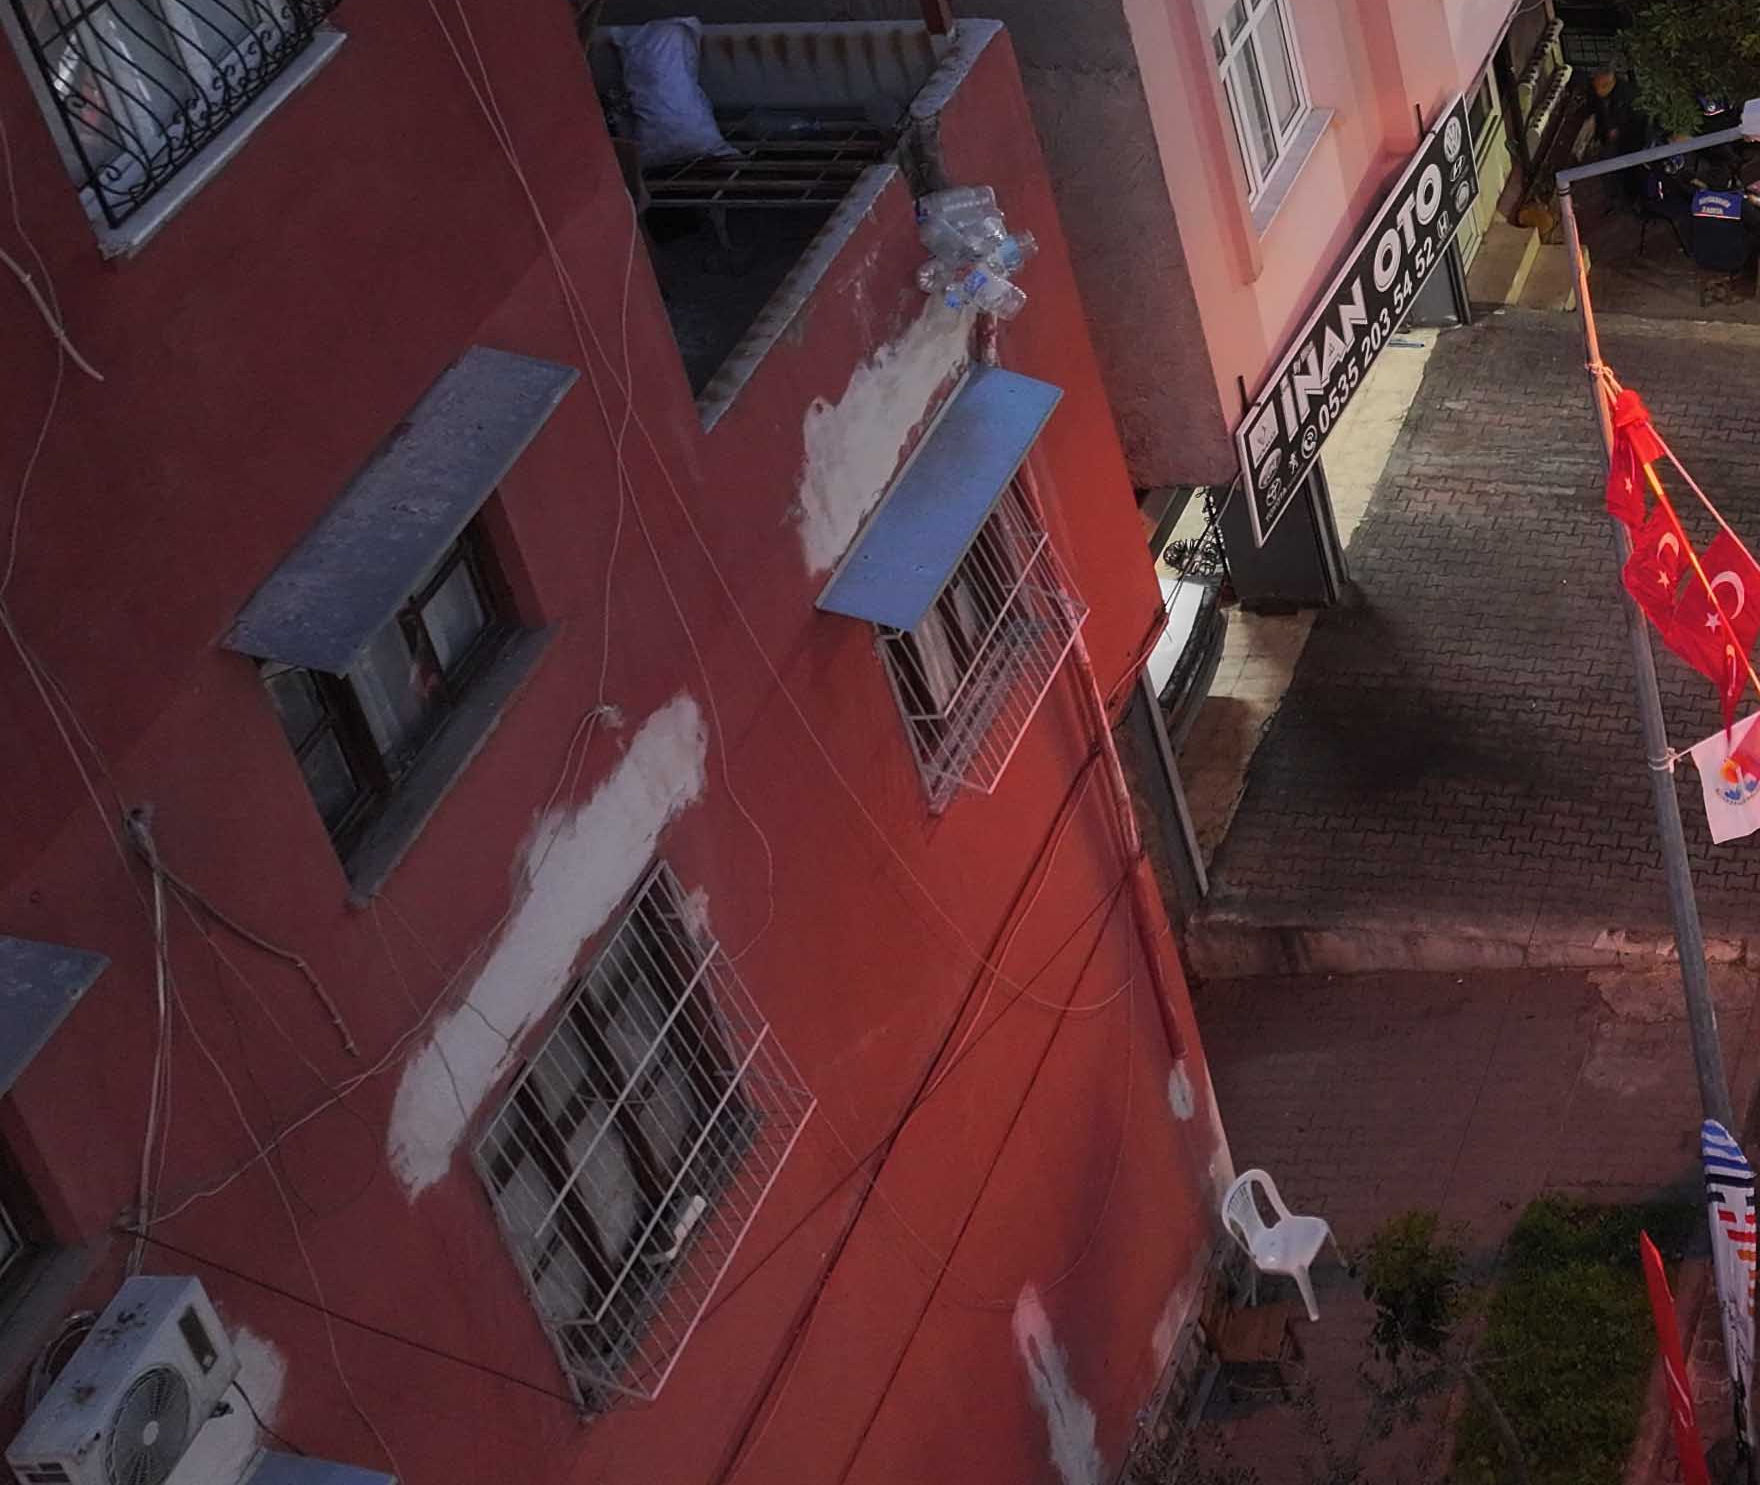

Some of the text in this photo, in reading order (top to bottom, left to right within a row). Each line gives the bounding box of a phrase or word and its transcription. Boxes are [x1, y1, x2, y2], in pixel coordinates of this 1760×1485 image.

[1373, 163, 1443, 293] OTO
[1318, 235, 1435, 435] 0535 203 54 52
